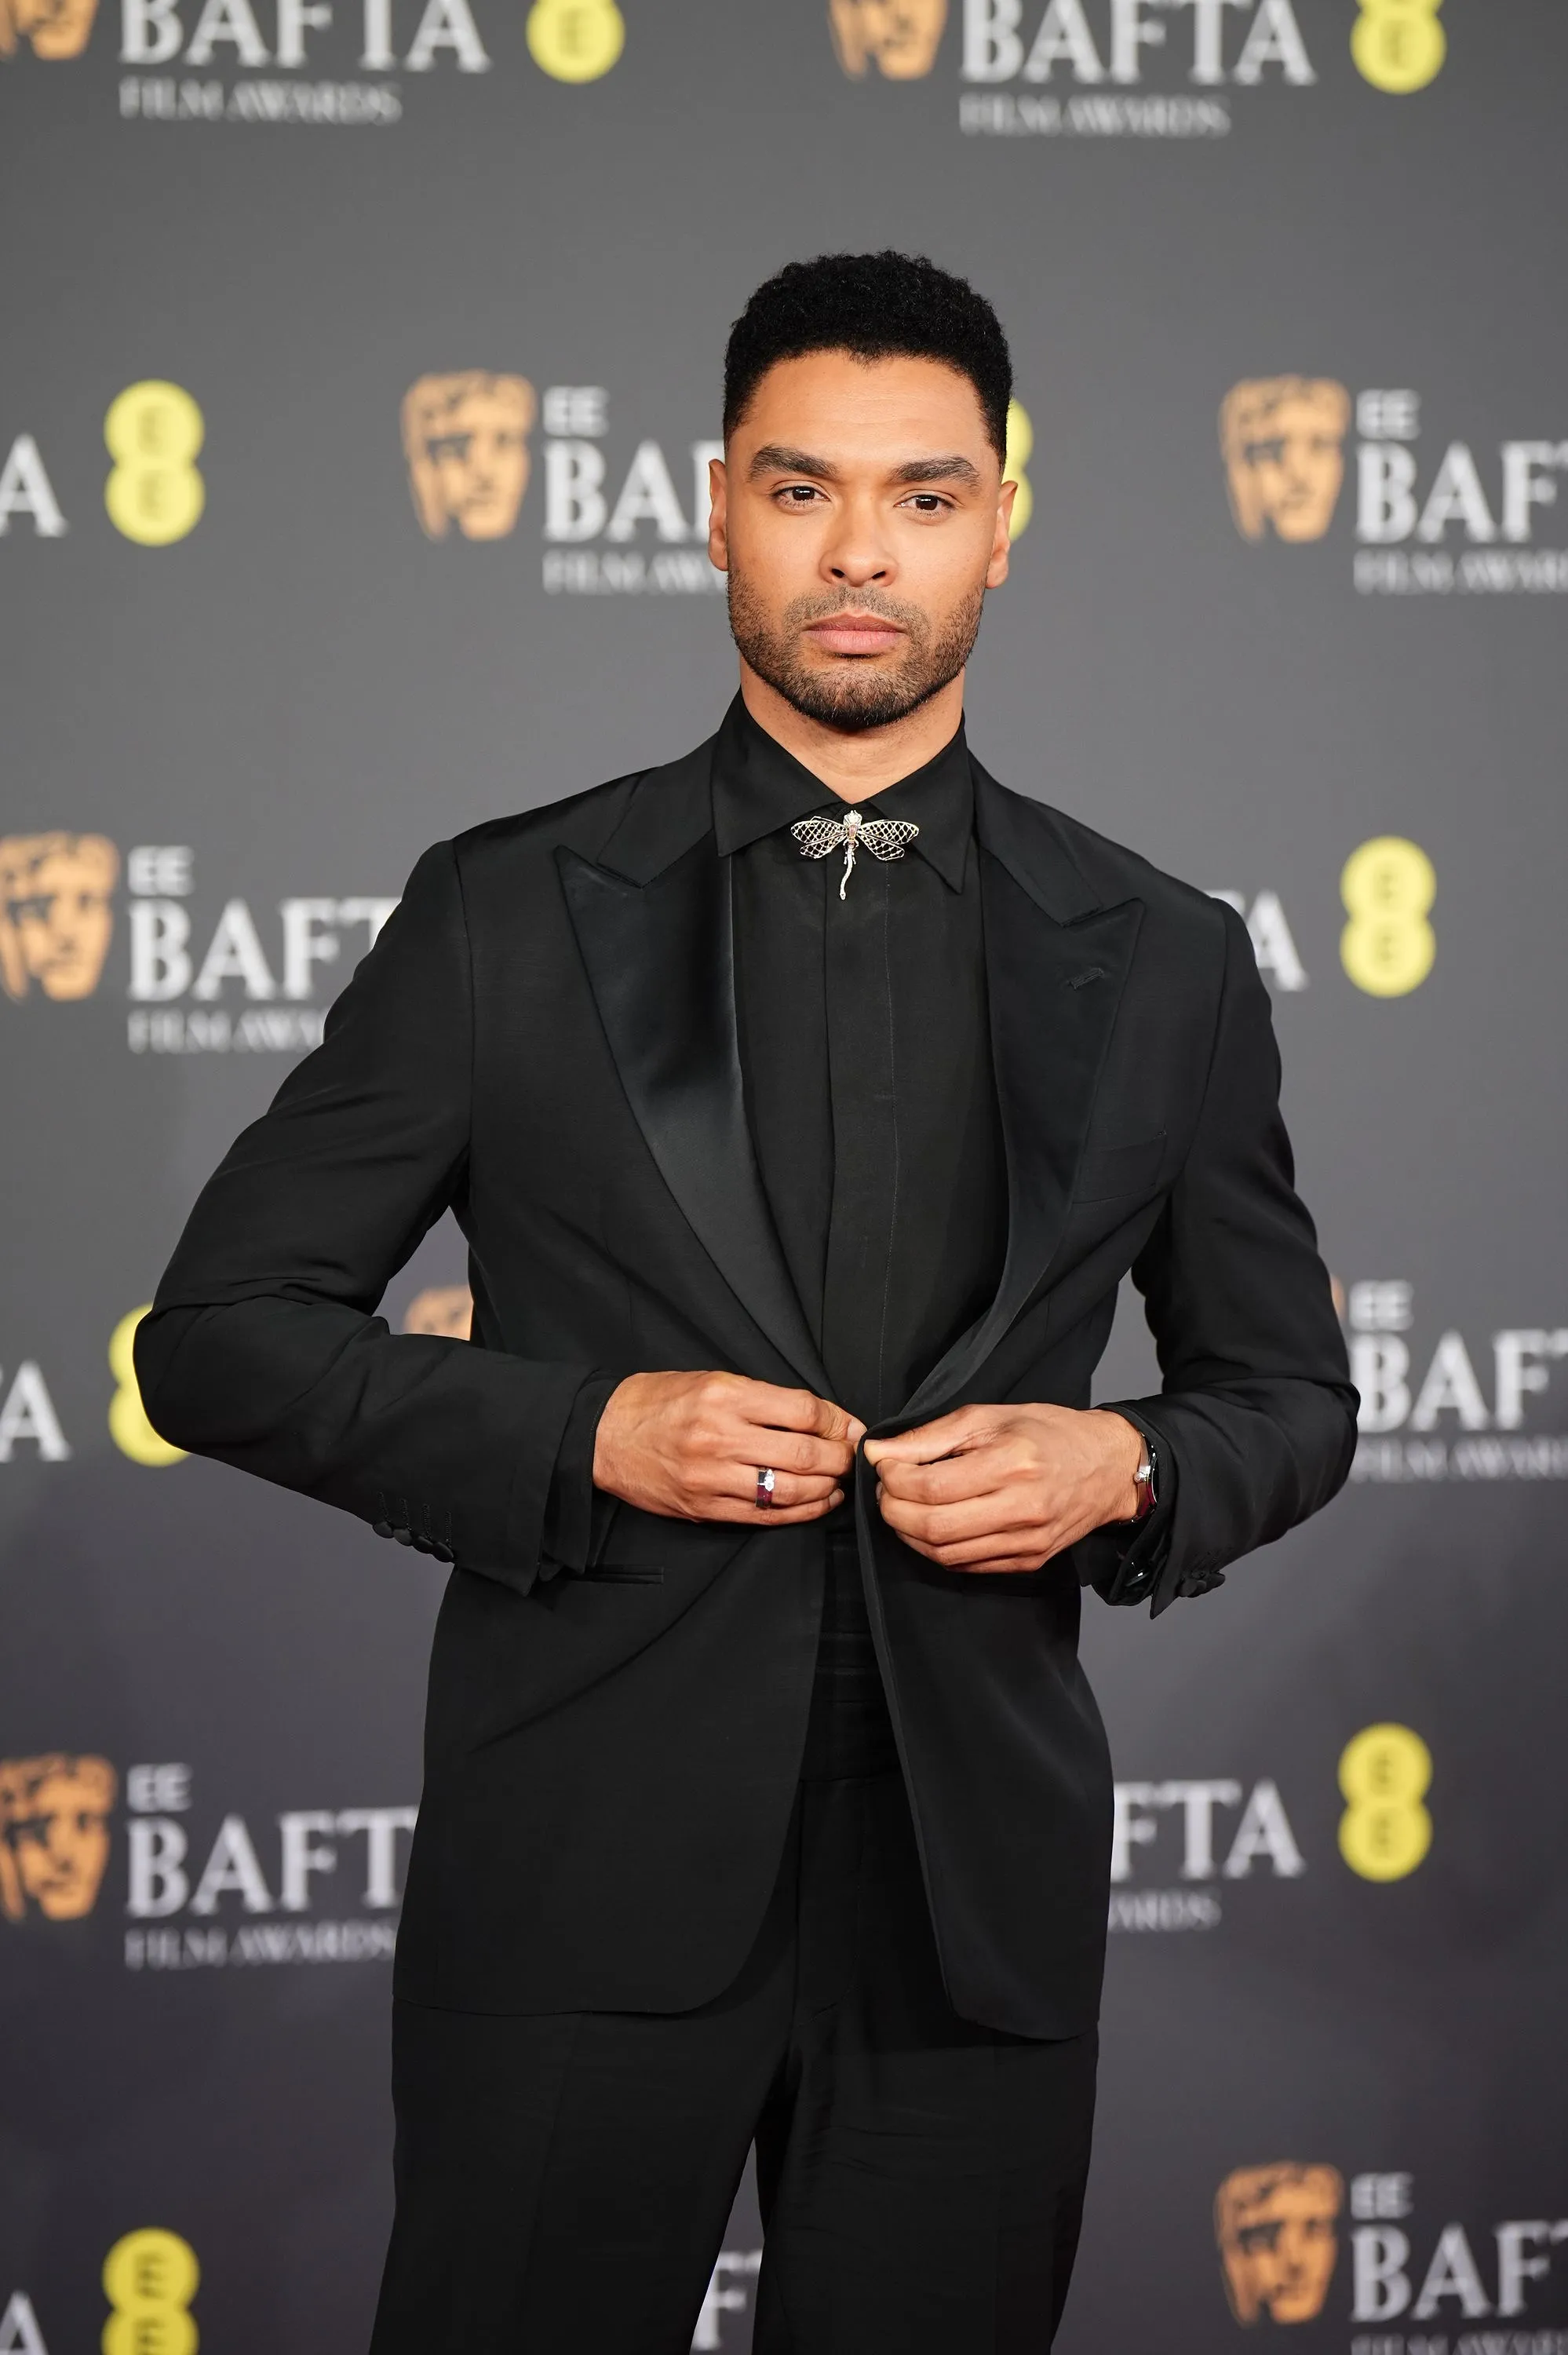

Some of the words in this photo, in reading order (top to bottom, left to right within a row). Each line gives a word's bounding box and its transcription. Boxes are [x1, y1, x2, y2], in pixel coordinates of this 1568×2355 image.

[119, 0, 490, 72] BAFTA
[960, 0, 1316, 84] BAFTA
[1355, 440, 1568, 543] BAF
[128, 897, 400, 1000] BAFT
[1350, 1330, 1568, 1433] BAF
[126, 1805, 419, 1918] BAFT
[1110, 1778, 1304, 1881] FTA
[1351, 2220, 1568, 2322] BAF
